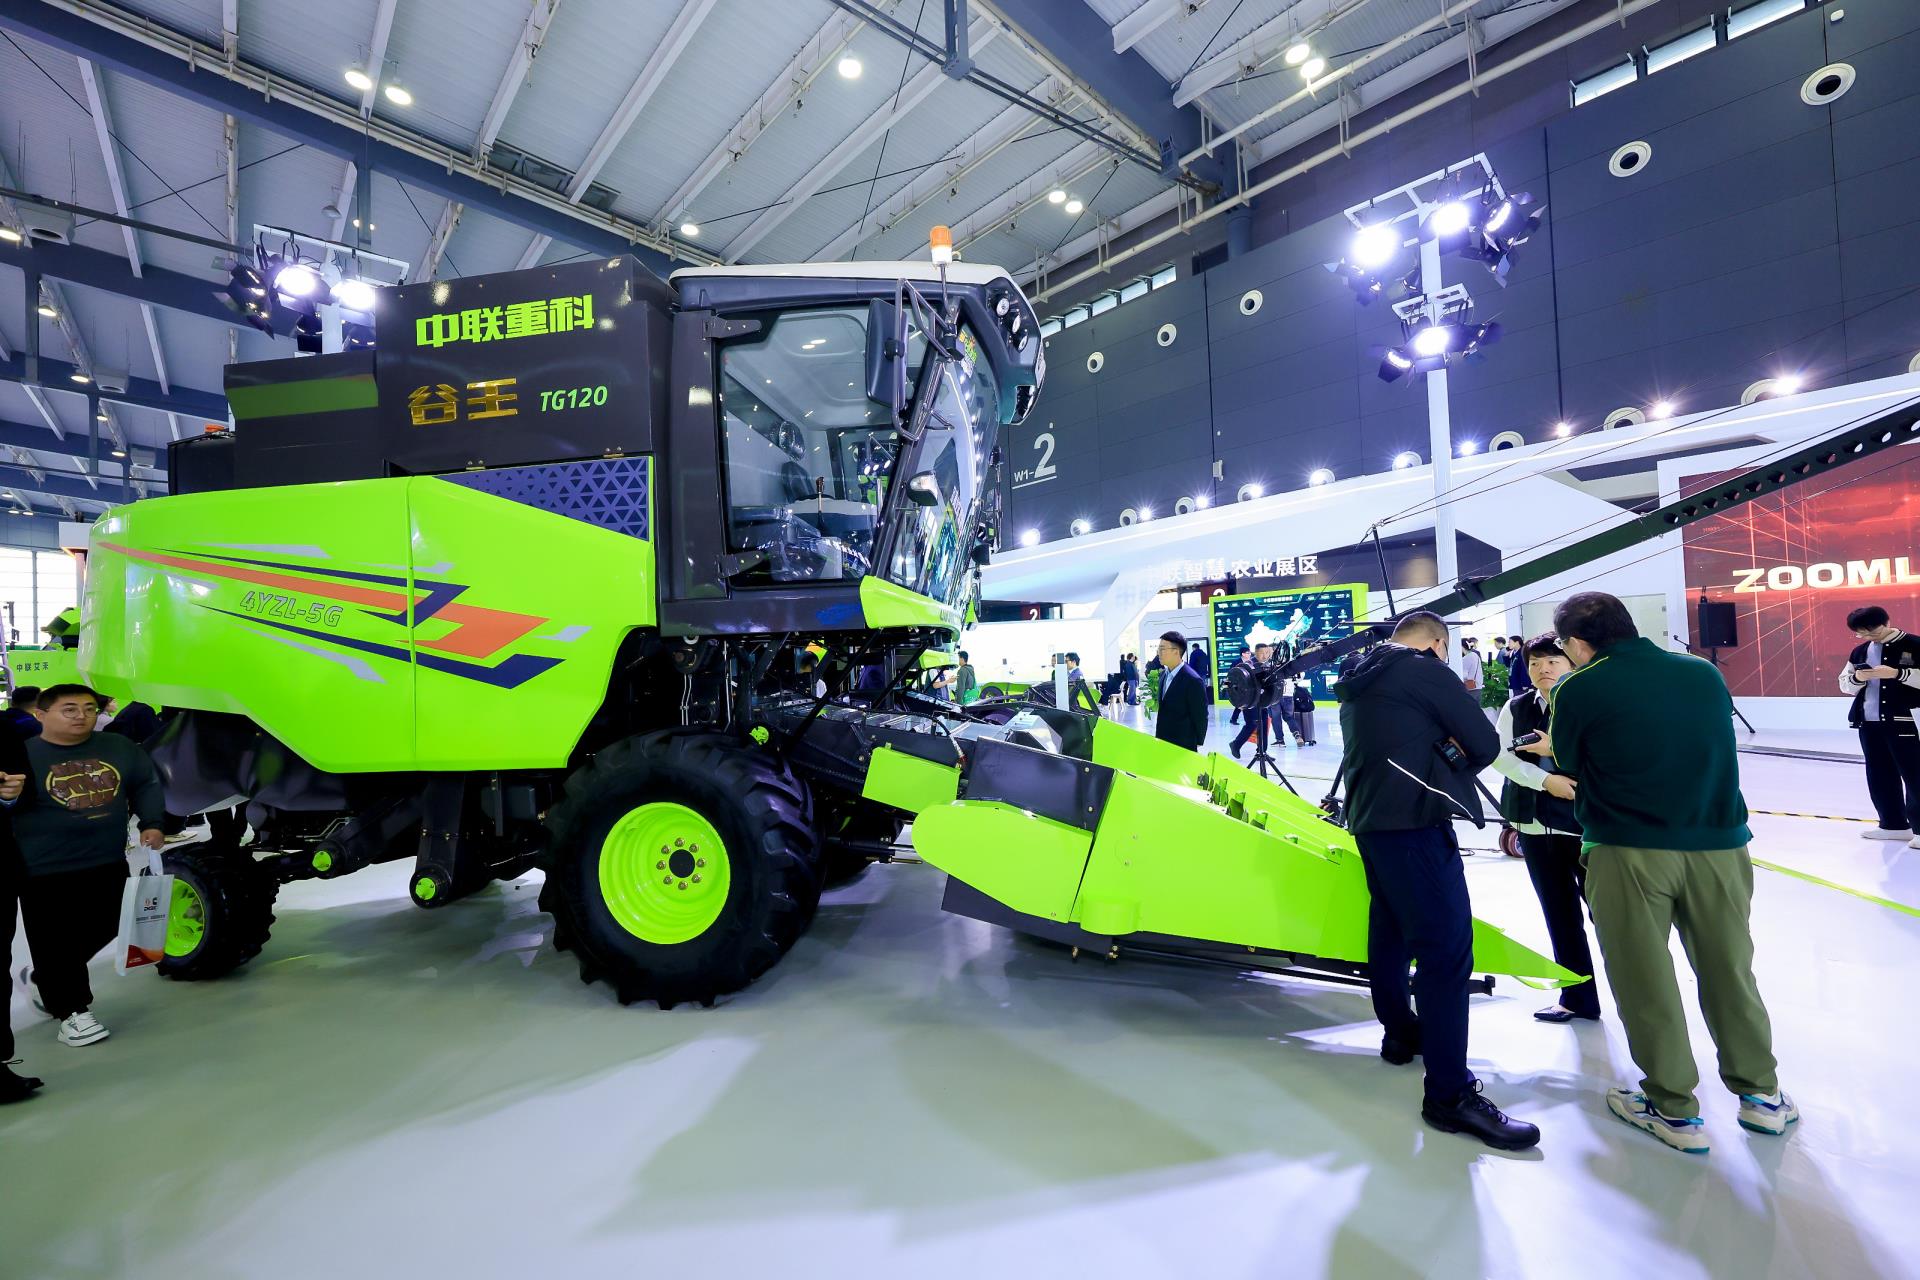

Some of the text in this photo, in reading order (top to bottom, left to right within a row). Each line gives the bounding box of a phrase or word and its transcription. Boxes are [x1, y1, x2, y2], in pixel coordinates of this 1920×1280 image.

[416, 294, 595, 348] 中联重科
[408, 378, 518, 425] 谷王
[540, 385, 609, 412] TG120
[1014, 433, 1056, 483] W1-2
[1148, 555, 1319, 582] 联智慧农业展区
[1732, 556, 1920, 594] ZOOML
[240, 591, 344, 627] 4YZL-5G
